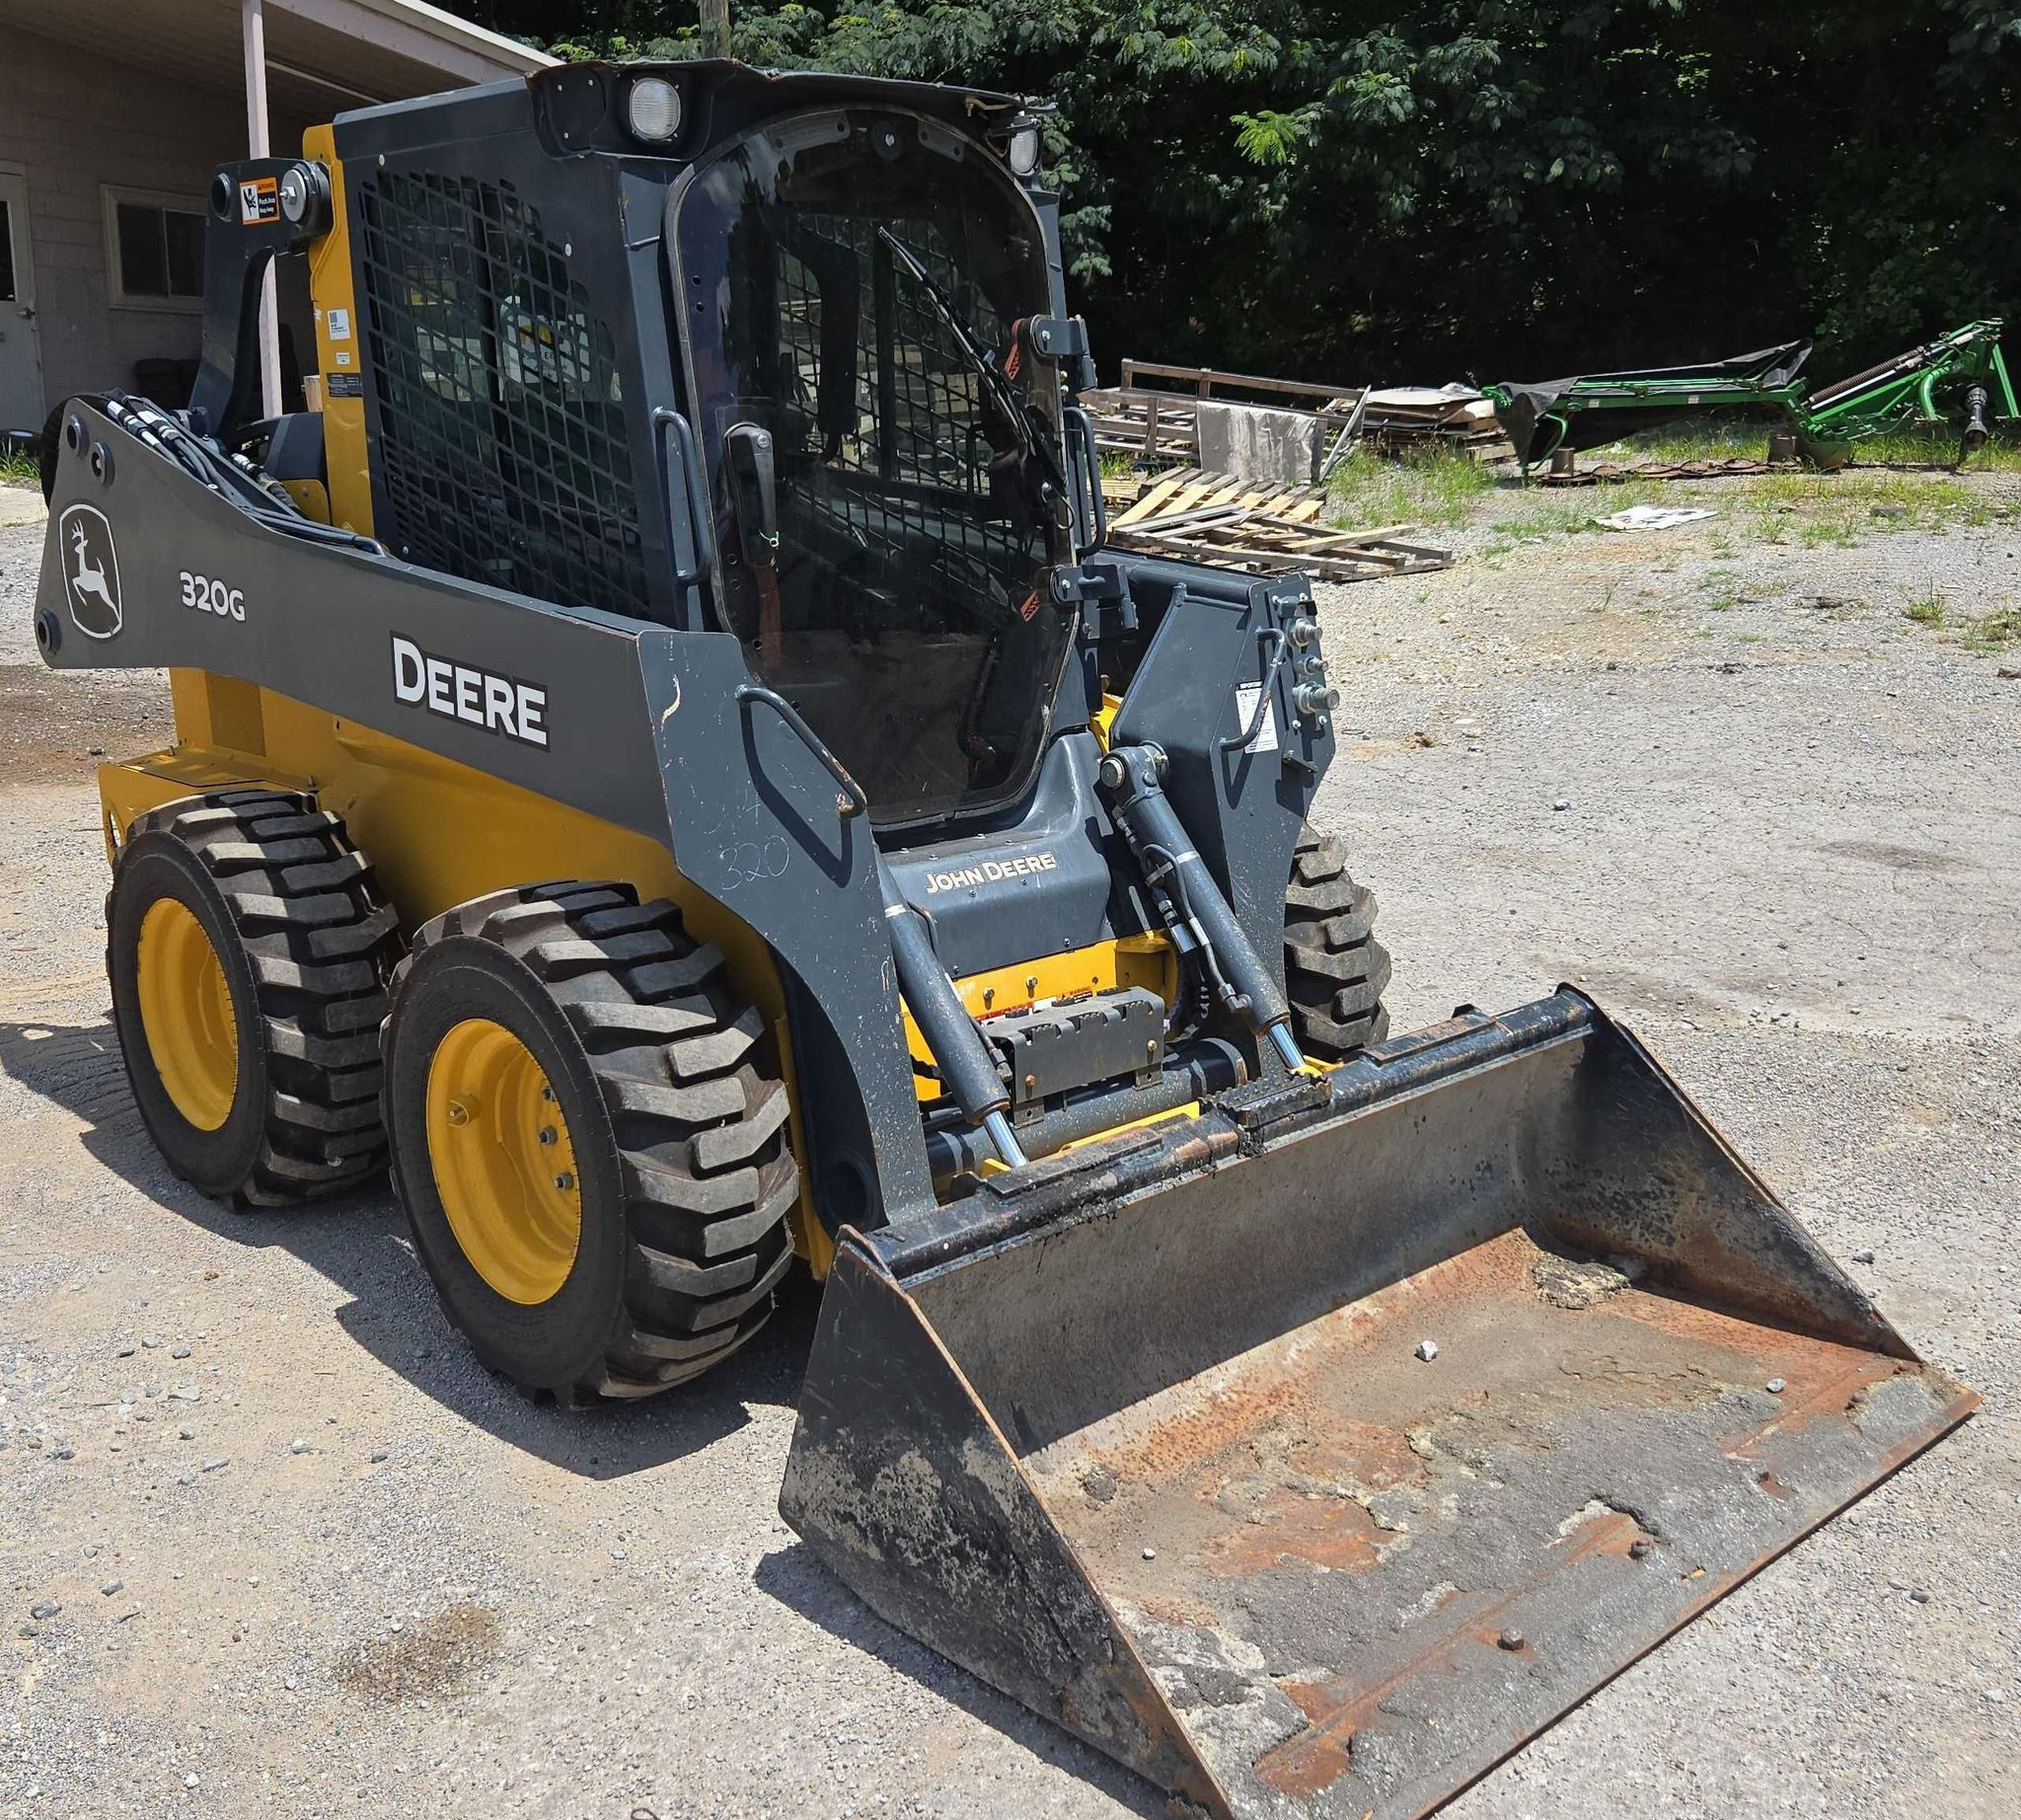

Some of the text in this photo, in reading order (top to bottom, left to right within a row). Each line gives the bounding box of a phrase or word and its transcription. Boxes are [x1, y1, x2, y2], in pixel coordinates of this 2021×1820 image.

[180, 571, 246, 622] 320G
[393, 637, 548, 745] DEERE
[719, 835, 790, 890] 320
[926, 852, 1058, 894] JOHN DEERE
